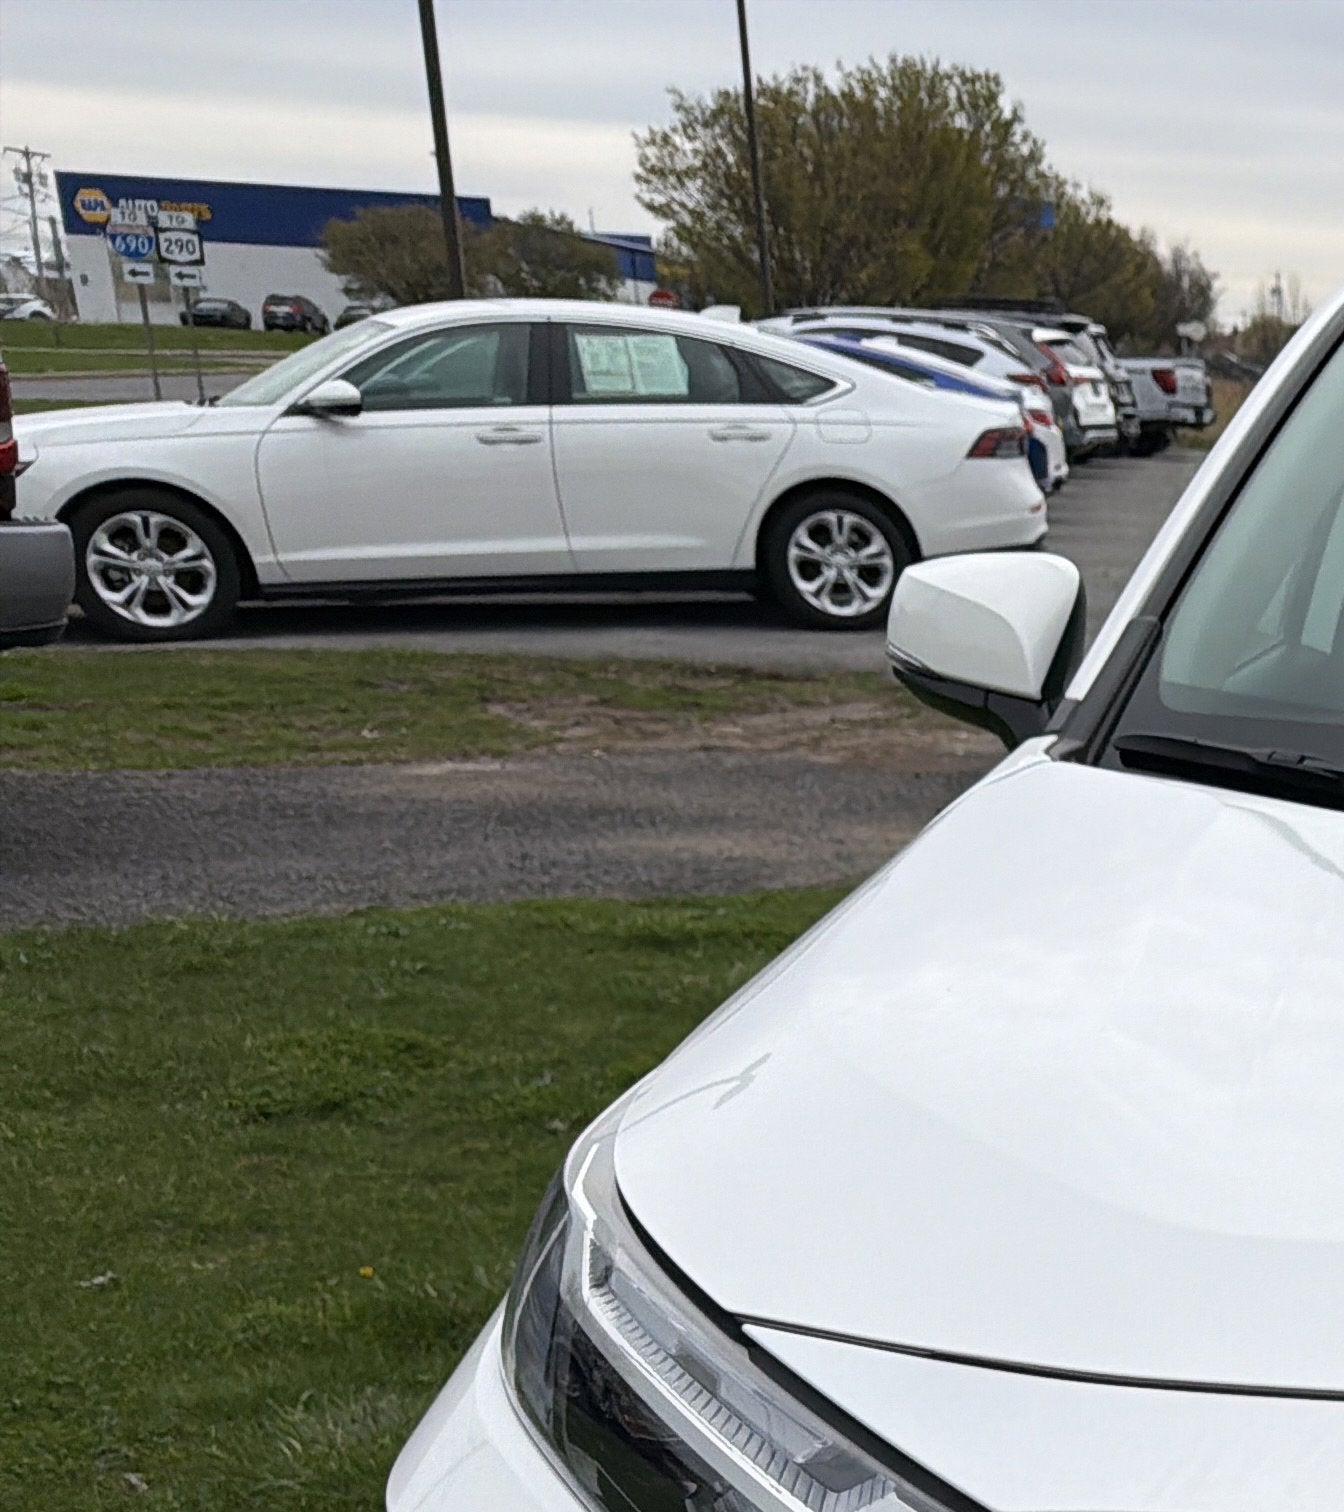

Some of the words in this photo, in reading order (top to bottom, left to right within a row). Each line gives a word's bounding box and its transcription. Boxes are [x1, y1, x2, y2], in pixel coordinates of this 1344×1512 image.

[120, 210, 137, 222] TO
[167, 213, 185, 224] TO
[115, 234, 149, 255] 690
[163, 237, 196, 256] 290
